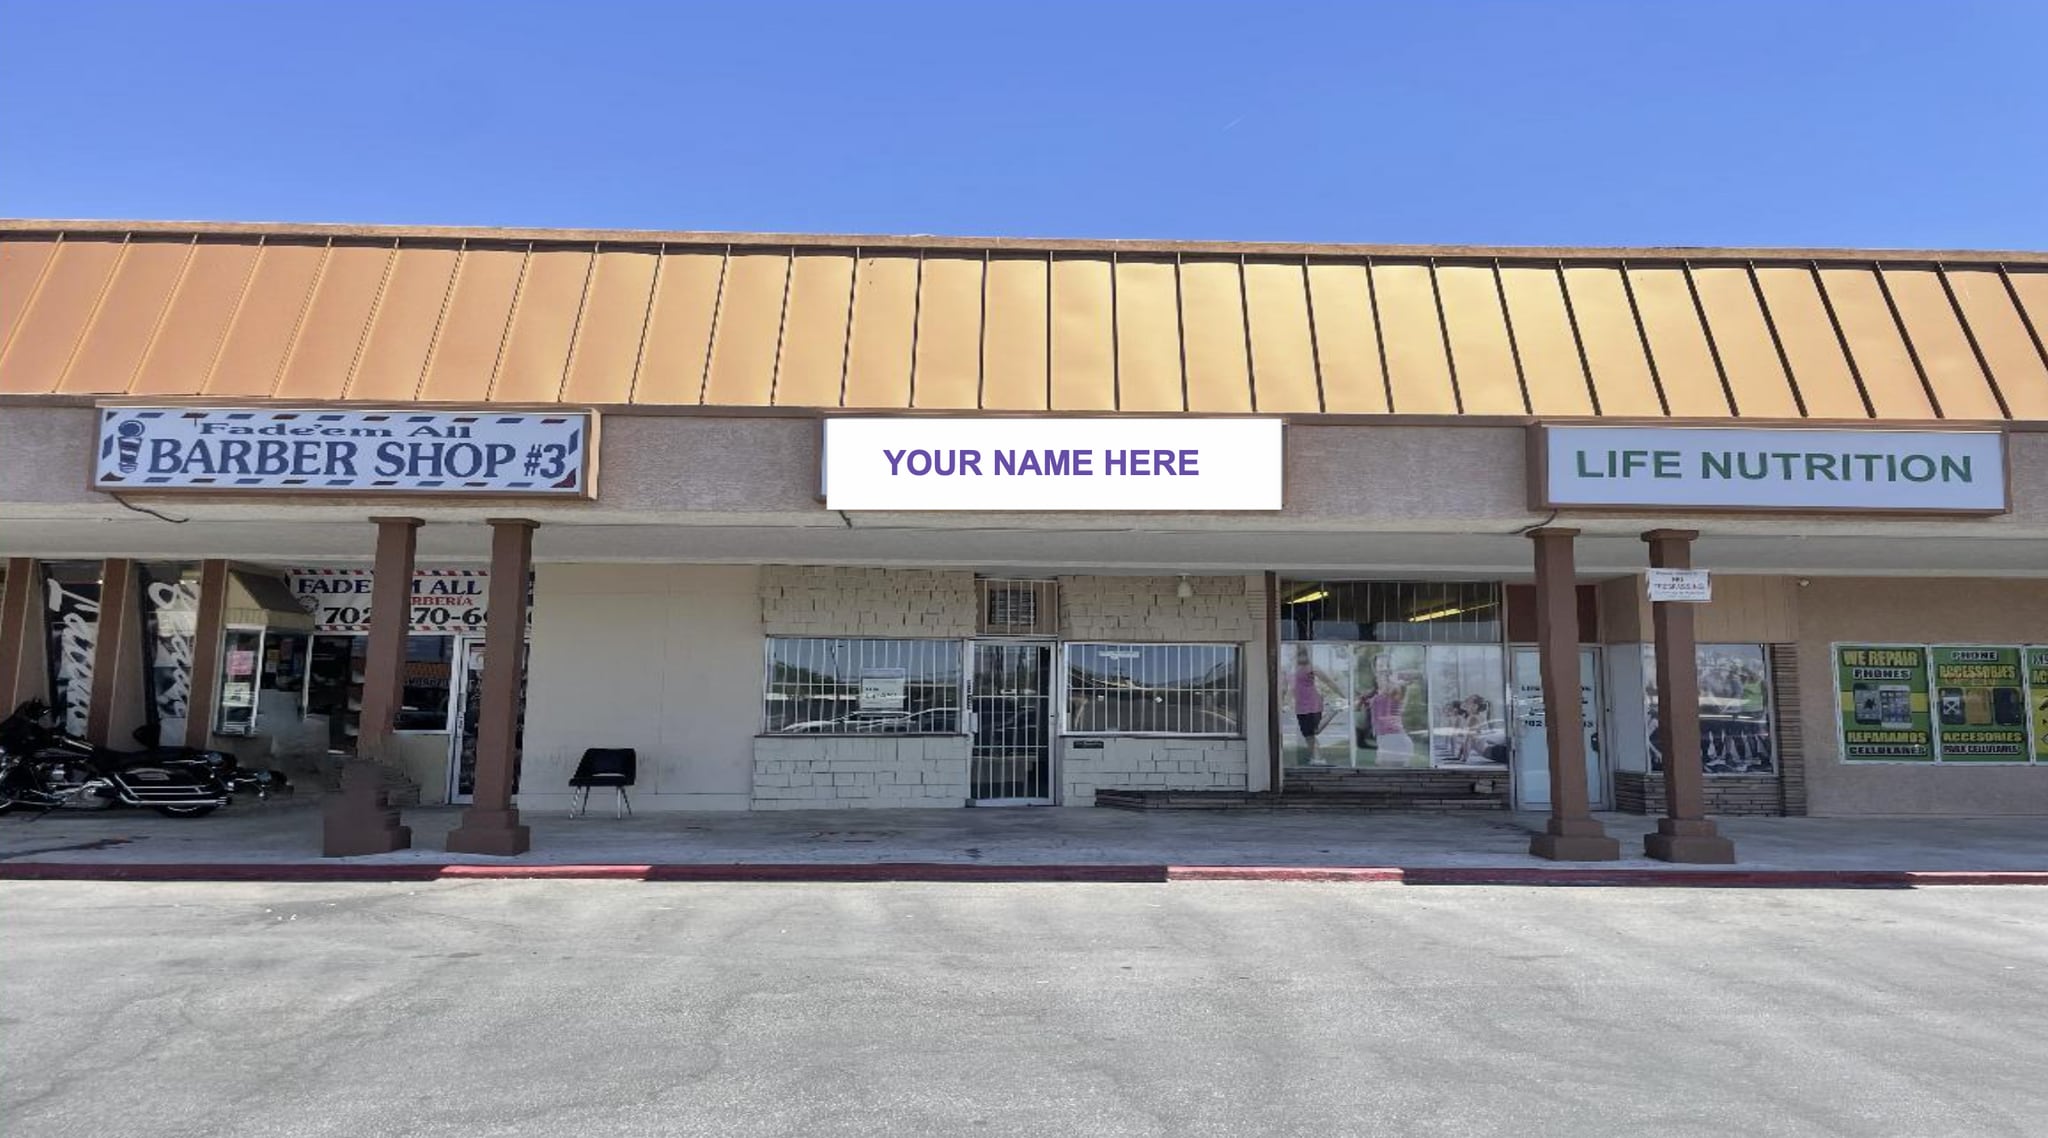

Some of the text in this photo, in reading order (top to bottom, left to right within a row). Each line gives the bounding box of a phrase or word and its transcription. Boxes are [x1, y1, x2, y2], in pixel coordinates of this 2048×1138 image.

[200, 422, 472, 438] Fade'em All
[150, 438, 567, 478] BARBER SHOP #3
[1576, 450, 1973, 483] LIFE NUTRITION
[430, 580, 482, 595] ALL
[1843, 650, 1918, 667] WE REPAIR
[1951, 651, 1998, 661] PHONE
[1853, 668, 1912, 679] PHONES
